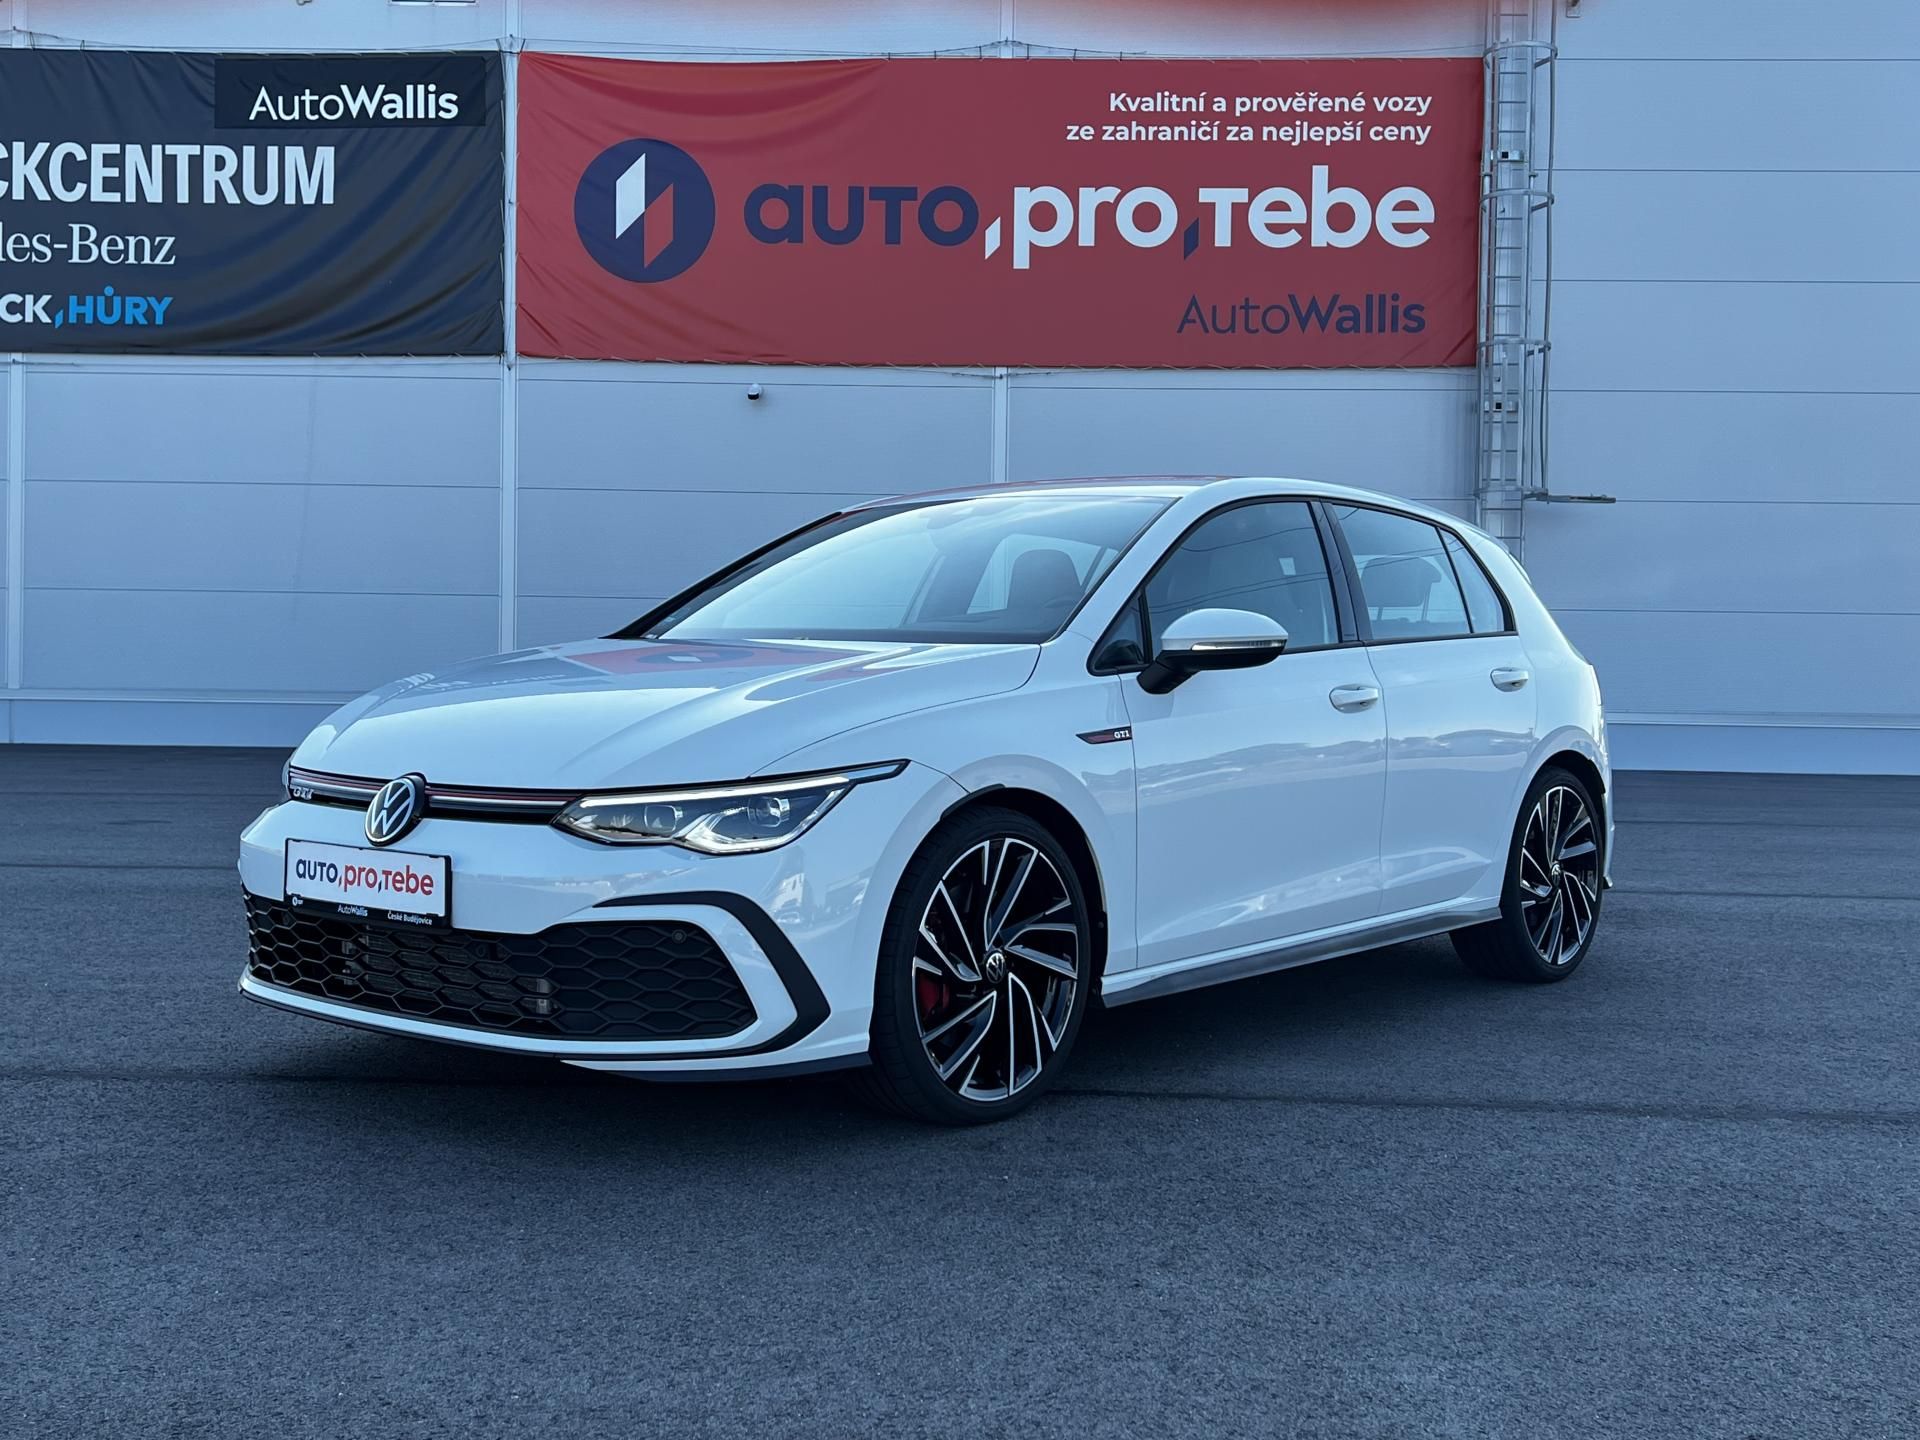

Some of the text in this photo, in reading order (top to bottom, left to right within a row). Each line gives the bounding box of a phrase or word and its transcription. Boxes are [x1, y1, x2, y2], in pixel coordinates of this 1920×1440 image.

[249, 84, 459, 121] AutoWallis
[1109, 92, 1432, 117] Kvalitní a prověřené vozy
[1066, 121, 1432, 146] ze zahraničí za nejlepší ceny
[0, 141, 335, 205] KCENTRUM
[1177, 293, 1426, 334] AutoWallis
[1114, 730, 1130, 739] GTI
